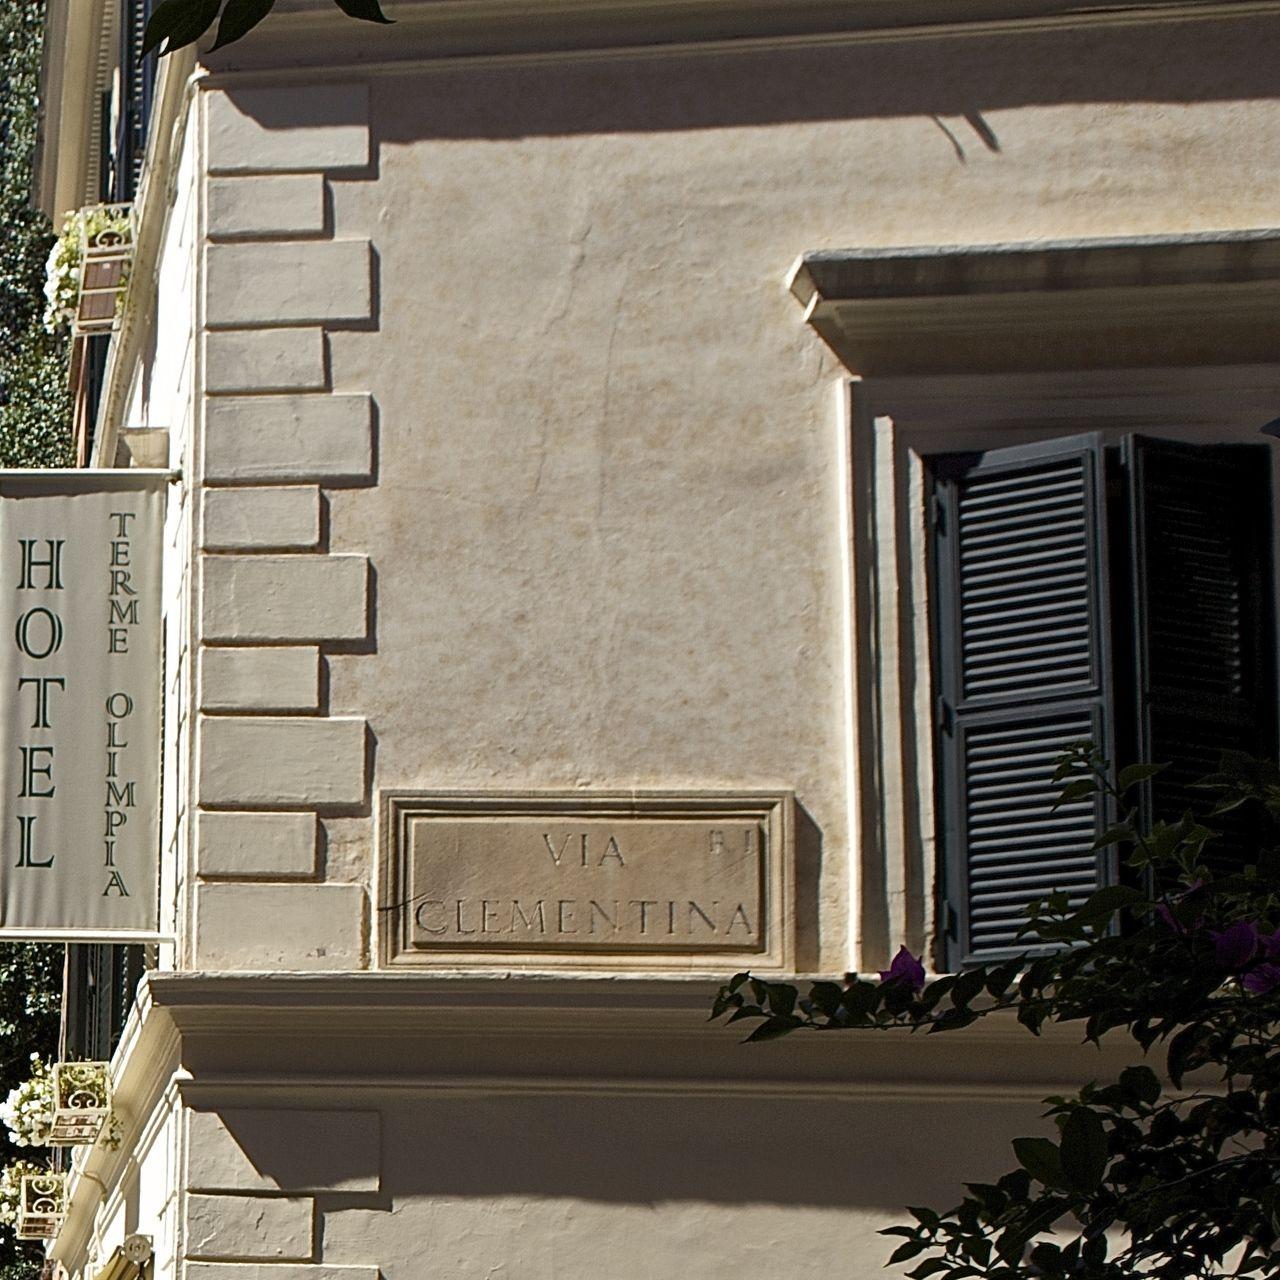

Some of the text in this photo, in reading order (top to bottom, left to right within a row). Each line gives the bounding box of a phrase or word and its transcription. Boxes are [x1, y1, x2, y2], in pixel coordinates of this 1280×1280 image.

[15, 539, 65, 869] HOTEL
[102, 512, 139, 897] TERME OLIMPIA
[414, 899, 754, 936] CLEMENTINA
[543, 833, 626, 867] VIA
